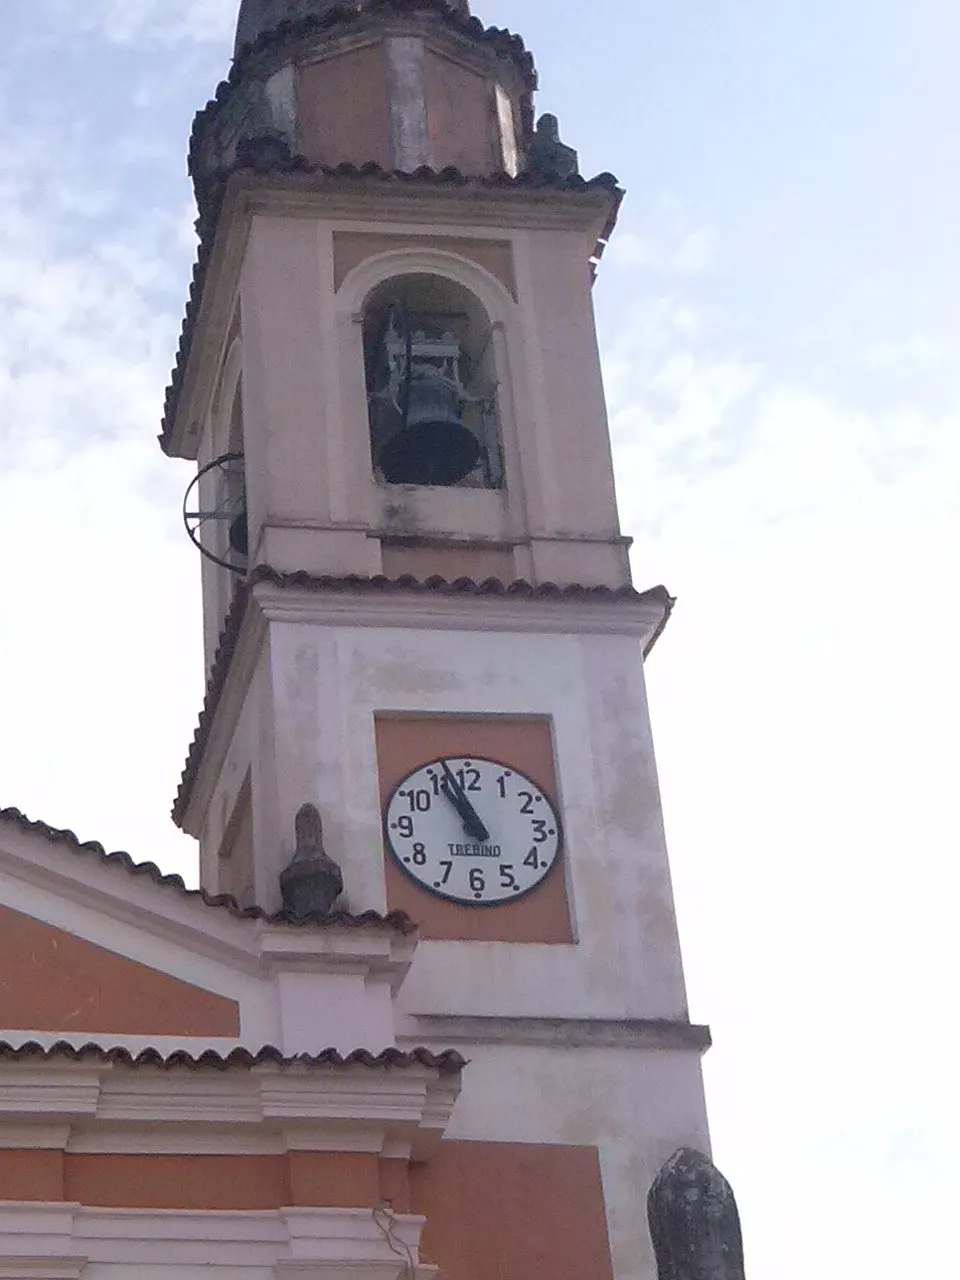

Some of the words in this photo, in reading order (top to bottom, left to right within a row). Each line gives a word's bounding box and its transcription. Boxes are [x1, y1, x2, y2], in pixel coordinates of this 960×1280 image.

[456, 769, 481, 791] 12
[497, 776, 506, 797] 1
[407, 789, 431, 811] 10
[517, 792, 534, 814] 2
[398, 816, 413, 838] 9
[531, 820, 547, 842] 3
[413, 843, 426, 865] 8
[448, 843, 501, 857] TREBINO
[523, 846, 538, 869] 4
[440, 861, 453, 883] 7
[469, 868, 485, 891] 6
[499, 864, 515, 887] 5
